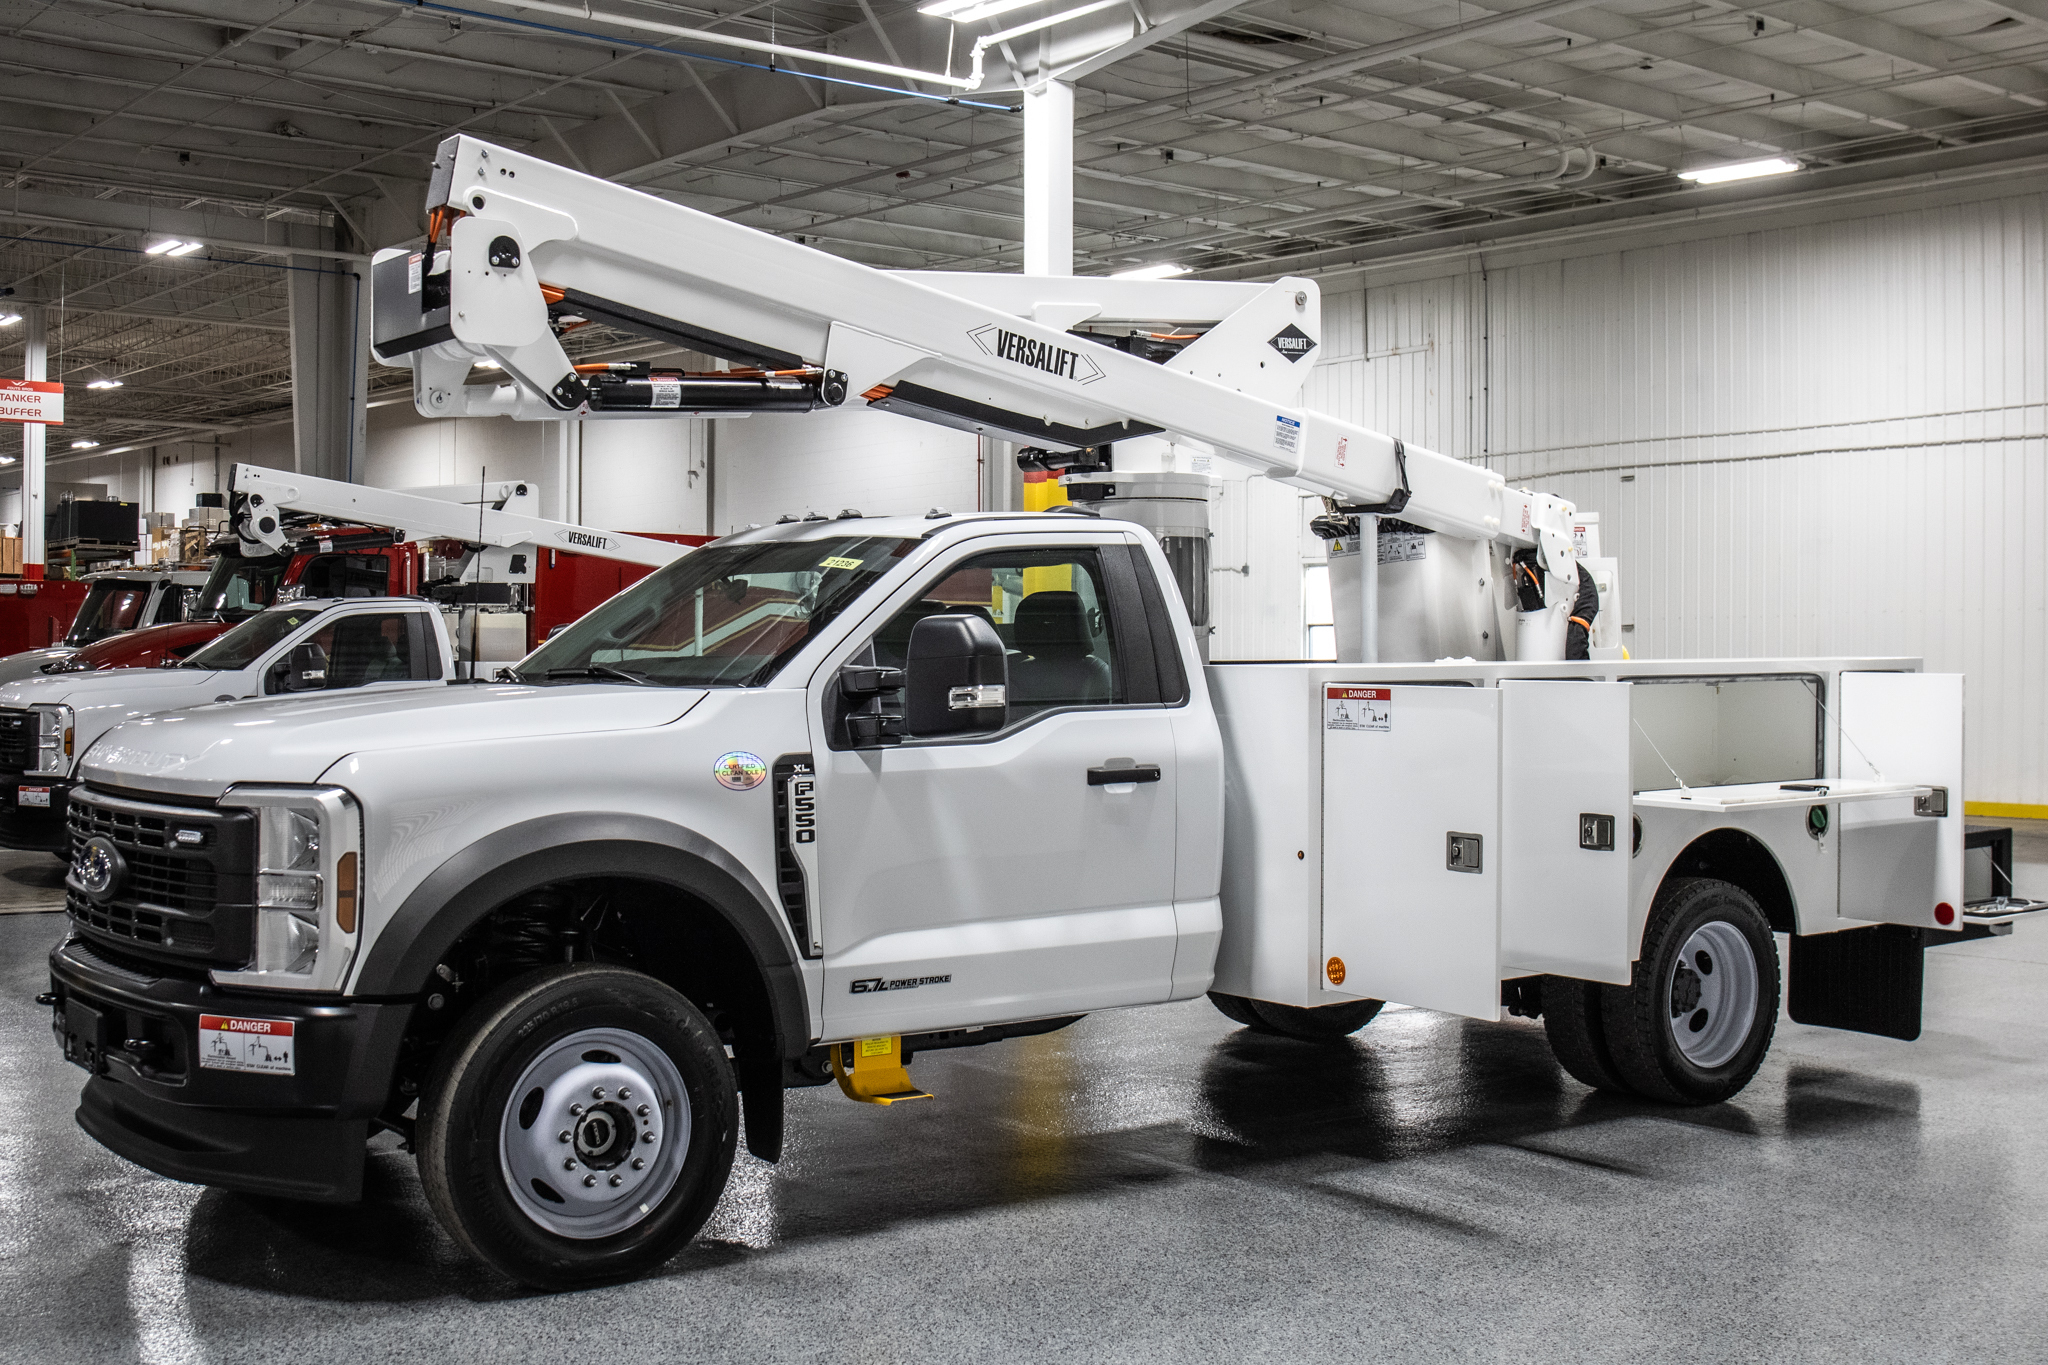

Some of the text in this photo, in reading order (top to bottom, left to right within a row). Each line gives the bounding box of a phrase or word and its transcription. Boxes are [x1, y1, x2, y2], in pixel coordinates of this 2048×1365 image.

[1277, 337, 1307, 350] VERSALIFT
[997, 328, 1079, 380] VERSALIFT
[0, 393, 41, 404] TANKER
[0, 406, 42, 417] BUFFER
[1281, 417, 1296, 426] NOTICE
[568, 530, 608, 550] VERSALIFT
[1348, 689, 1377, 699] DANGER
[793, 764, 811, 773] XL
[794, 780, 816, 844] F550
[850, 974, 950, 993] 6.7L POWER STROKE
[230, 1019, 271, 1034] DANGER
